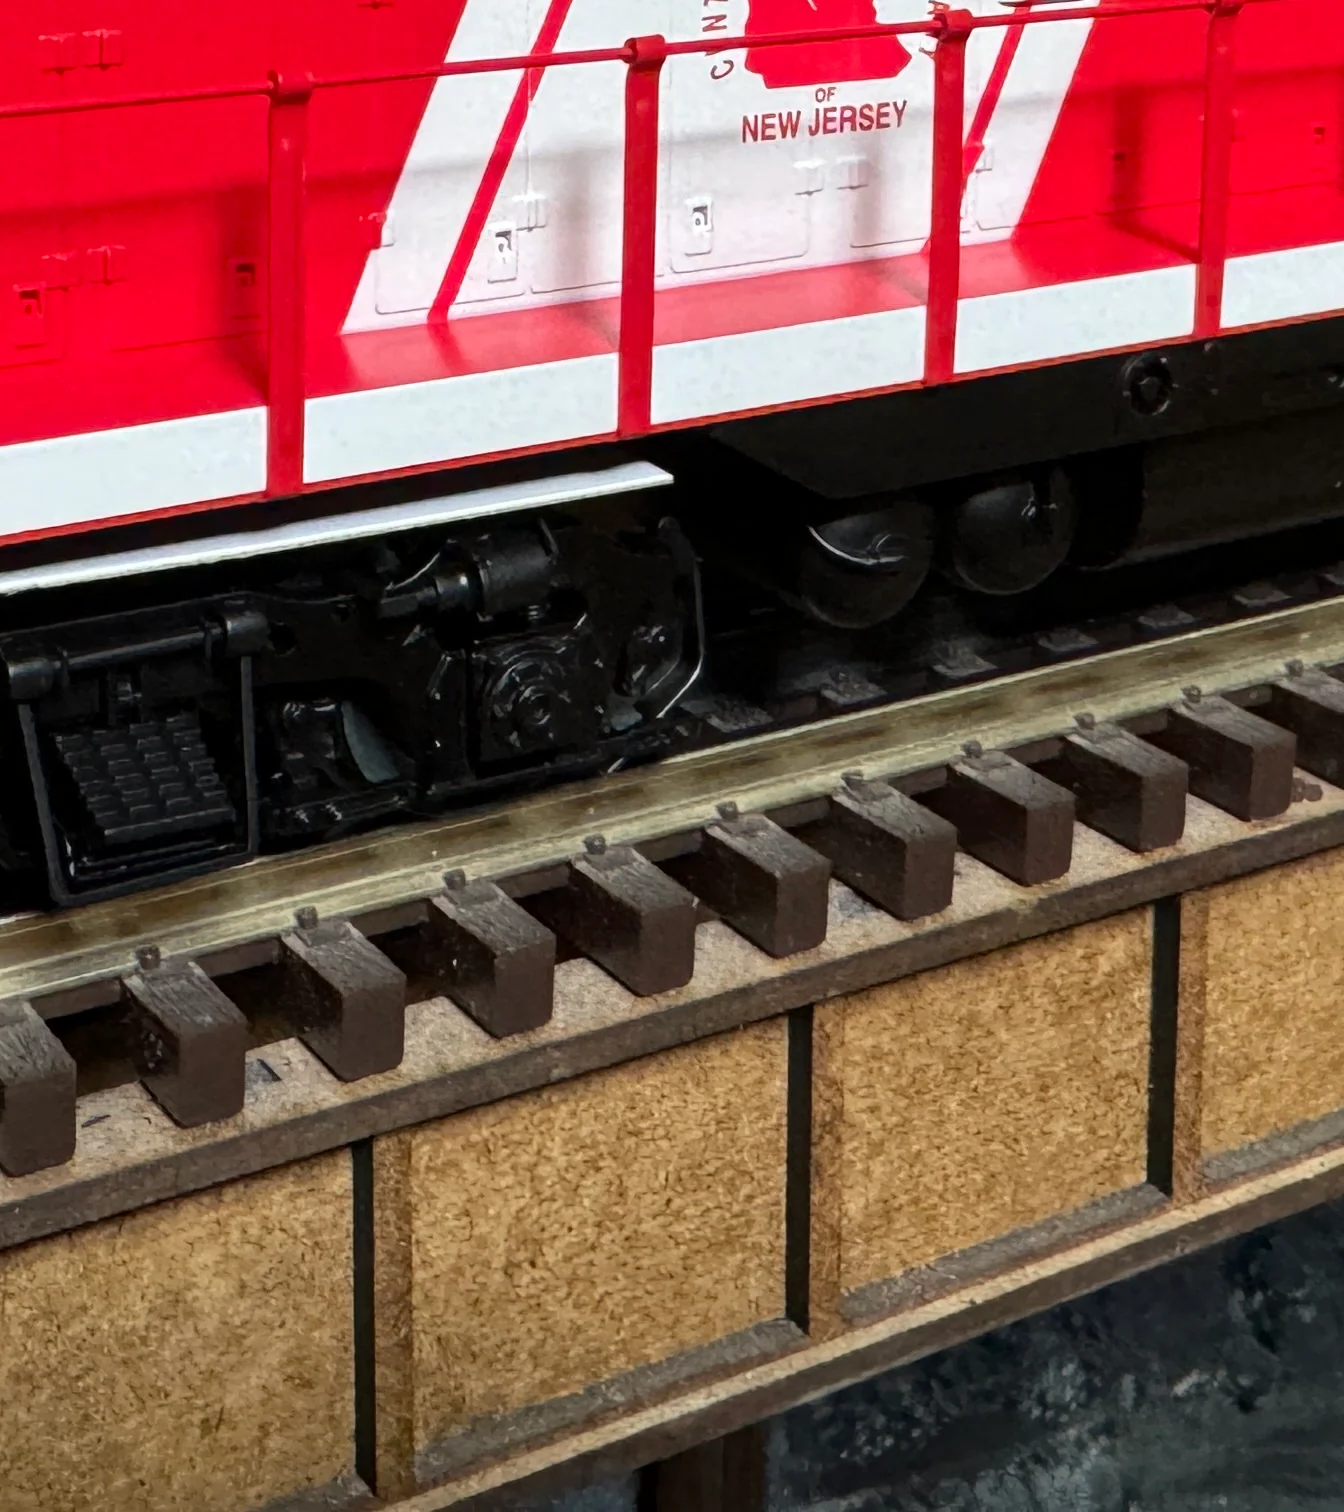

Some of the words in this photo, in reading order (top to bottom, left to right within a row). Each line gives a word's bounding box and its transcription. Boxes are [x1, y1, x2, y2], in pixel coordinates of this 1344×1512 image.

[815, 87, 837, 103] OF
[741, 109, 802, 143] NEW
[807, 100, 907, 137] JERSEY
